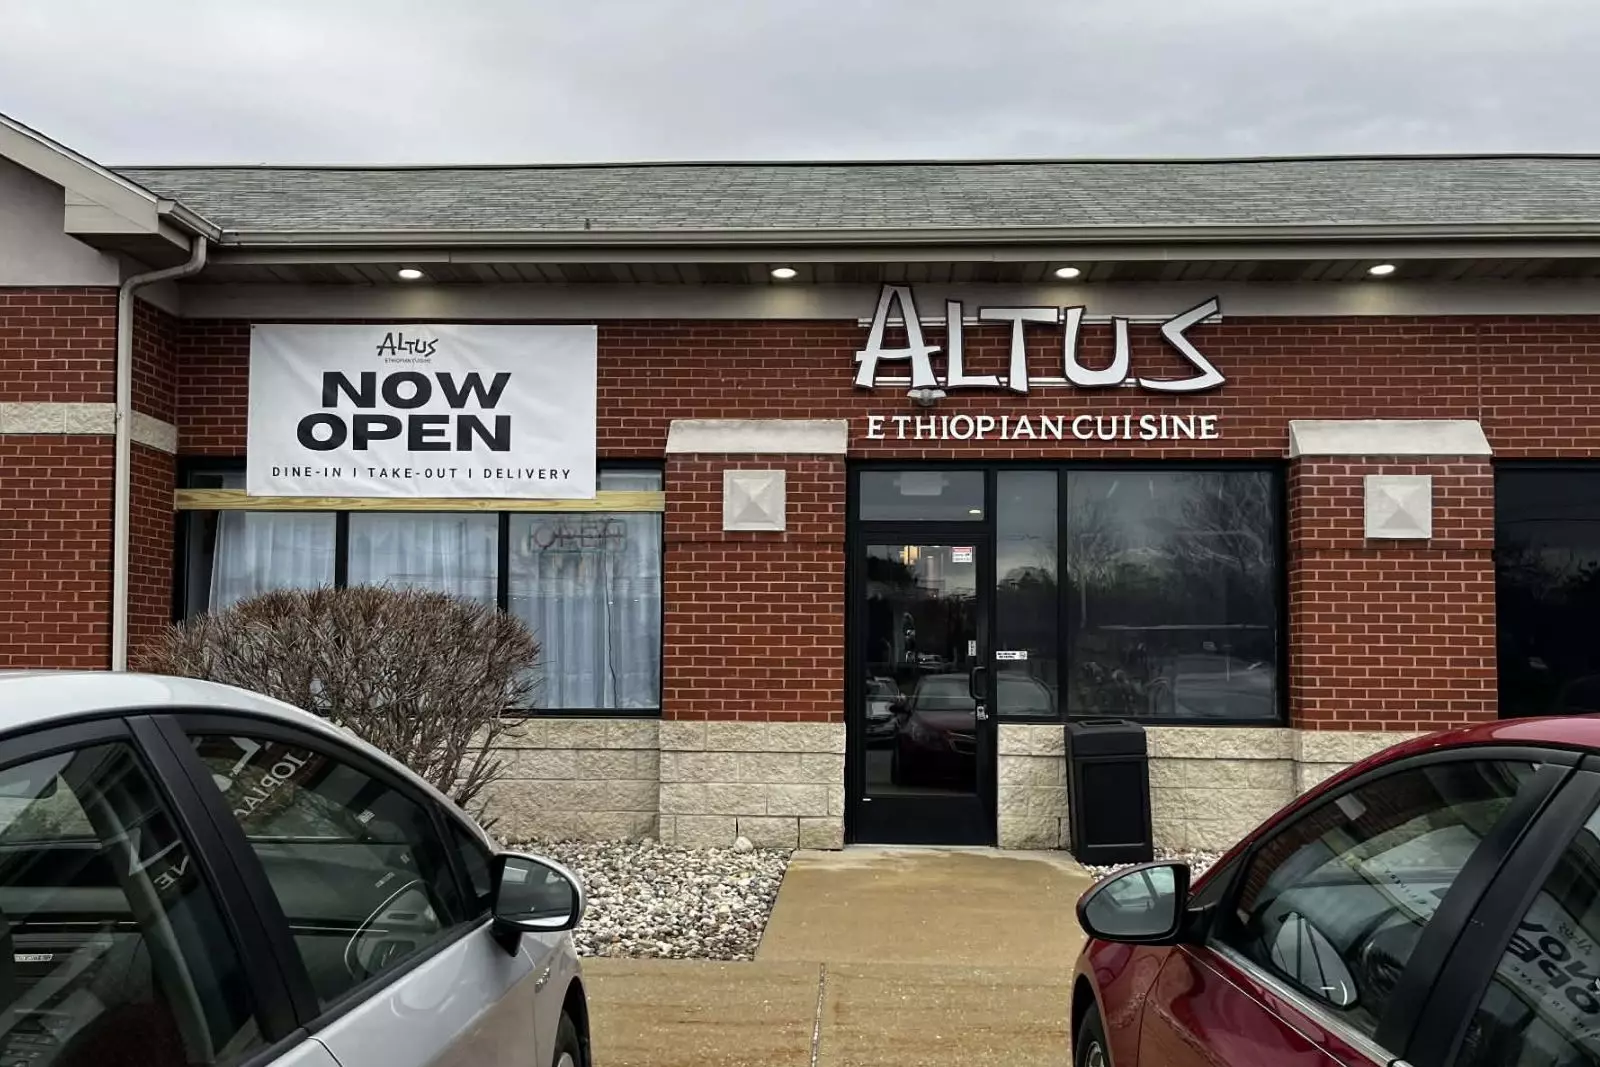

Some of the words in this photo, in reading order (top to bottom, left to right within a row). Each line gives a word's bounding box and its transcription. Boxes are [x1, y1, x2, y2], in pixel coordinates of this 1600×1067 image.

[853, 284, 1227, 395] ALTUS
[321, 371, 512, 409] NOW
[296, 412, 511, 452] OPEN
[865, 414, 1066, 440] ETHIOPIAN
[1071, 414, 1220, 441] CUISINE
[272, 466, 342, 477] DINE-IN
[367, 467, 457, 479] TAKE-OUT
[483, 468, 571, 480] DELIVERY
